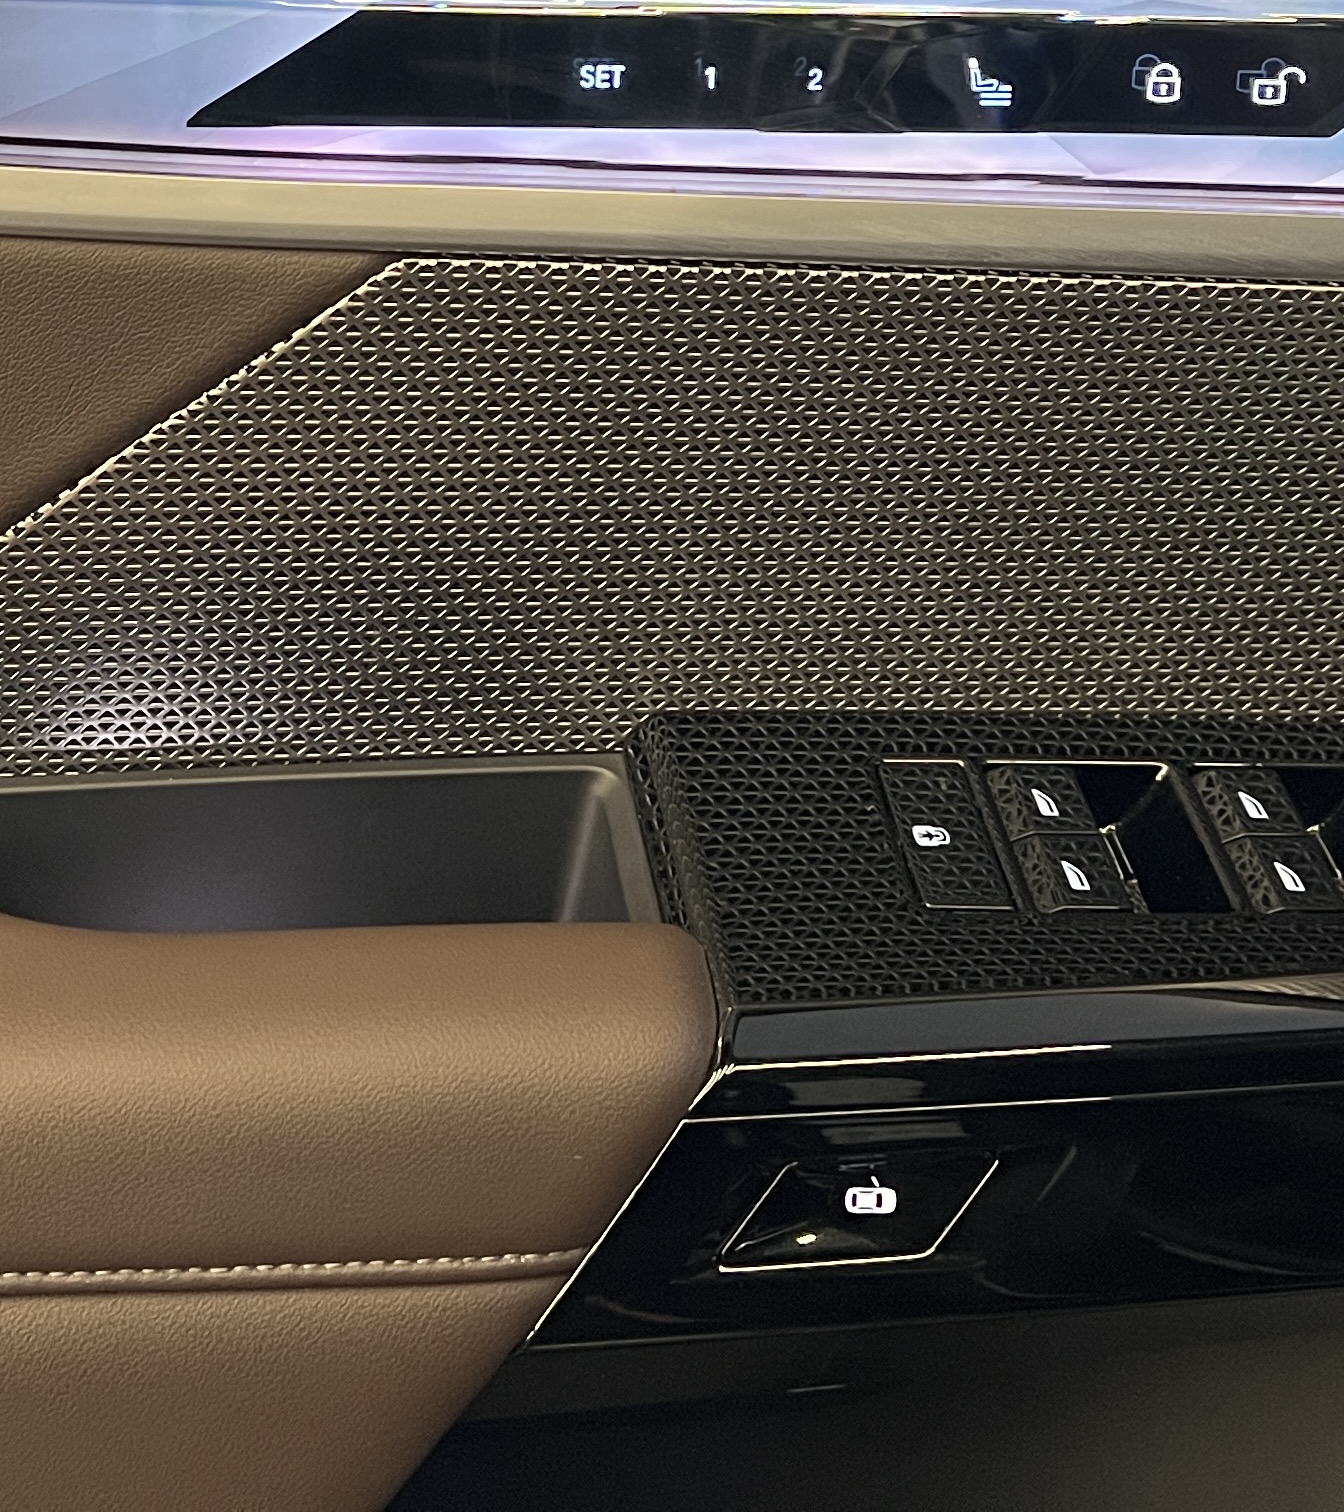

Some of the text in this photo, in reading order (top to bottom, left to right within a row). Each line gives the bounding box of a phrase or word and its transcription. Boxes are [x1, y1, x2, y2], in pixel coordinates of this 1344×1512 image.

[579, 64, 823, 91] SET 1 2
